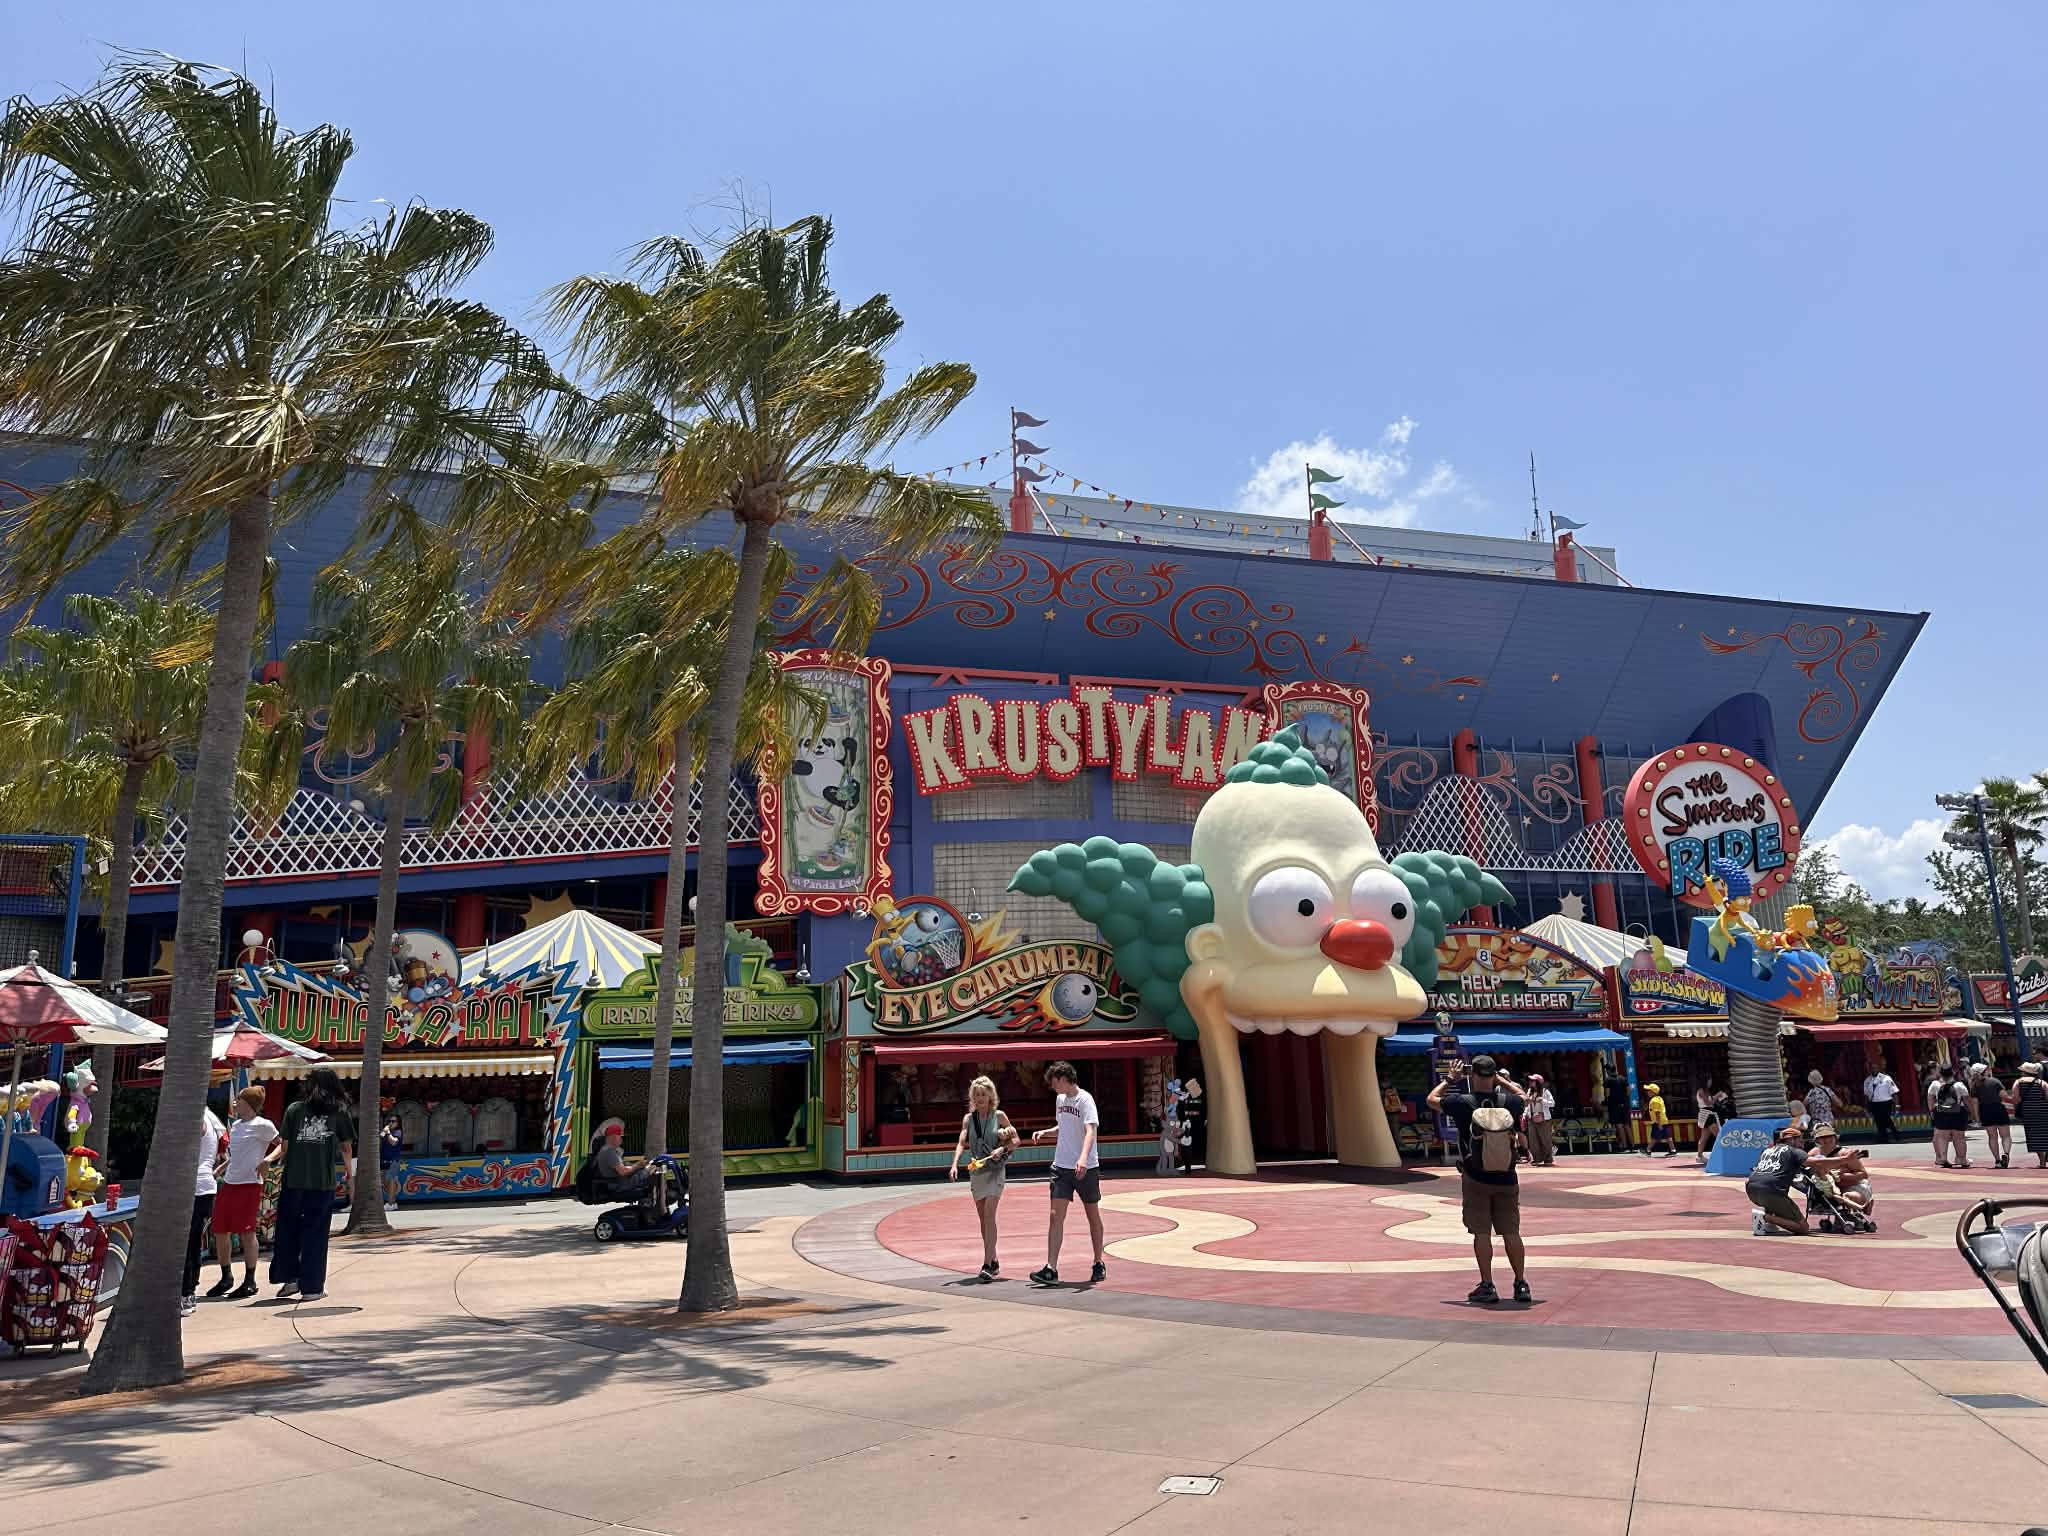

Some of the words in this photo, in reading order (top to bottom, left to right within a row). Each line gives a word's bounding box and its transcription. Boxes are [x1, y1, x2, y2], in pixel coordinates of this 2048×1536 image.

[904, 686, 1277, 793] KRUSTYLAN
[1666, 822, 1785, 897] RIDE
[803, 879, 836, 889] Panda
[839, 875, 862, 888] Land
[1479, 950, 1489, 962] 8
[881, 988, 949, 1025] EYE
[948, 945, 1113, 1012] CARUMBA!
[1425, 992, 1458, 1008] TA'S
[1462, 993, 1511, 1008] LITTLE
[1514, 992, 1567, 1008] HELPER
[1461, 974, 1502, 992] HELP
[1628, 968, 1726, 1008] SIDESHOW
[414, 1004, 452, 1044] A
[463, 984, 552, 1040] RAT
